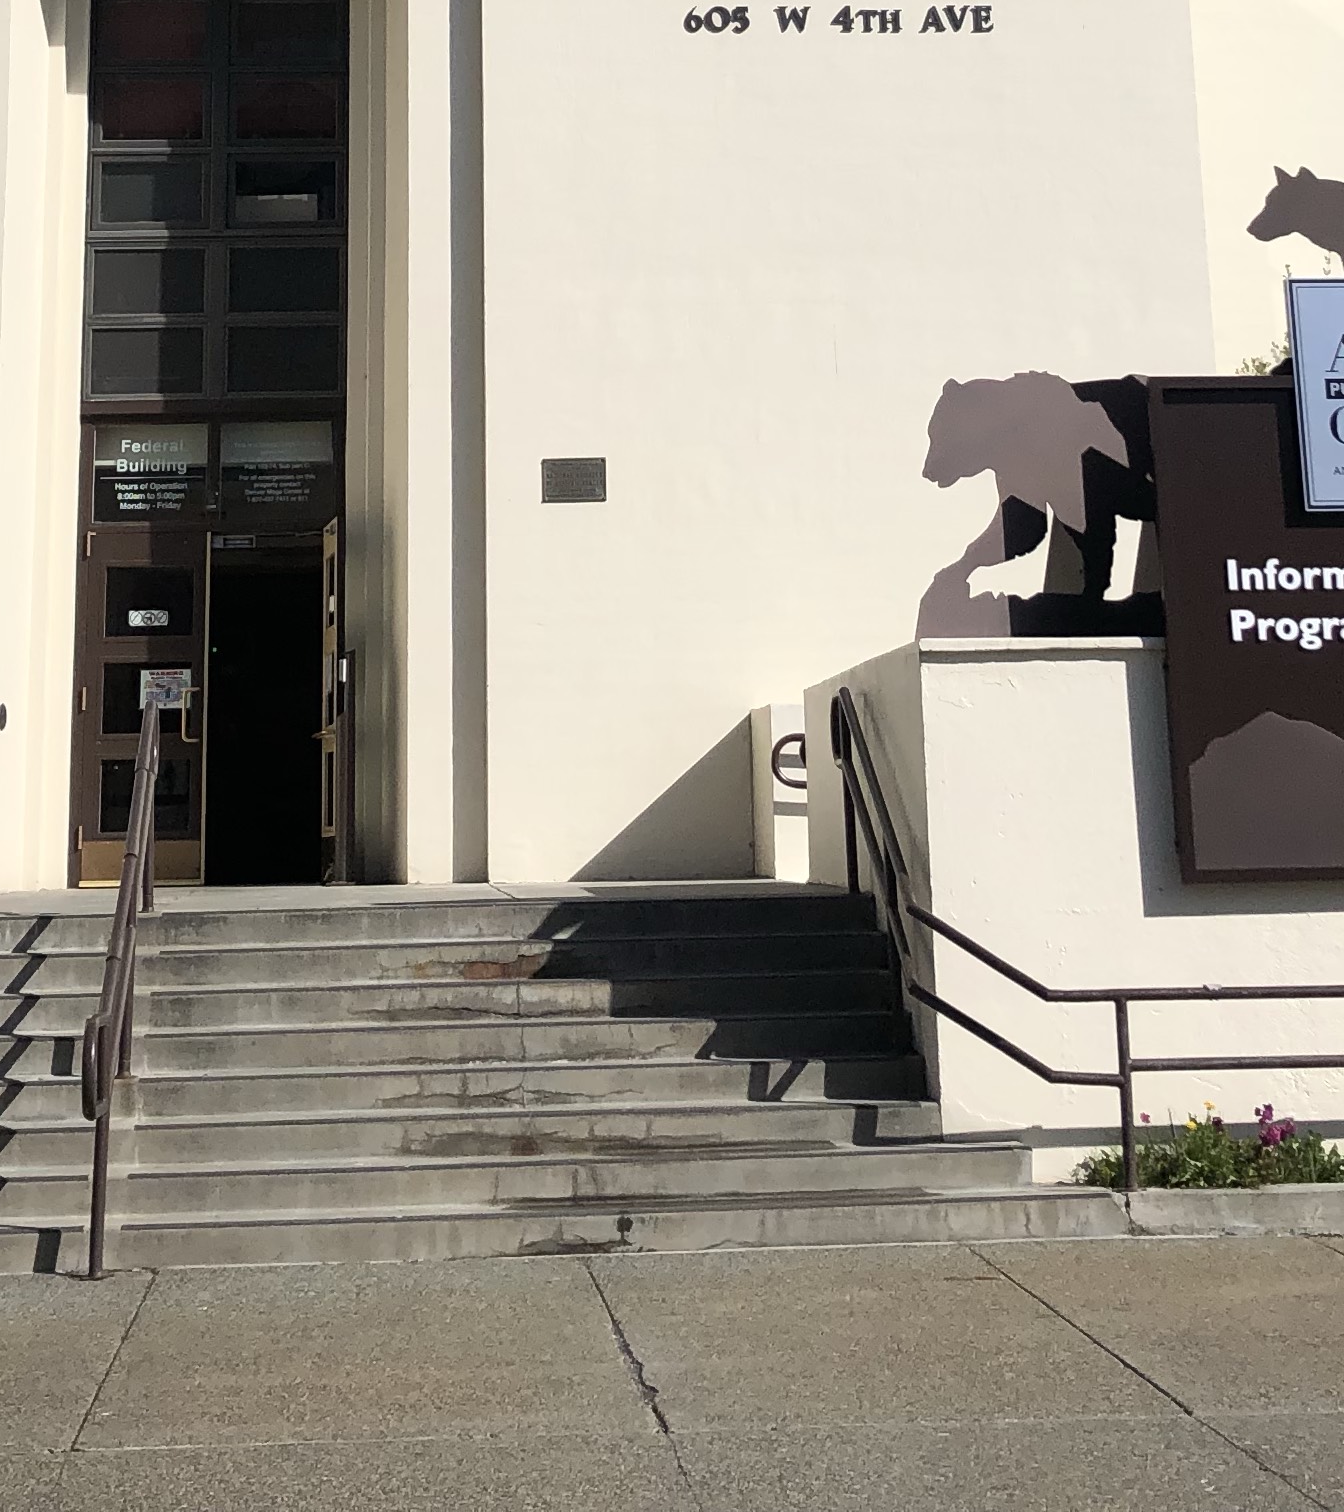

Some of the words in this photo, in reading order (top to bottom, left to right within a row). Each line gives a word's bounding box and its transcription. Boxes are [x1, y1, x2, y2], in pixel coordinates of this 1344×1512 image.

[683, 5, 750, 35] 605
[773, 5, 811, 35] W
[829, 4, 903, 35] 4TH
[918, 4, 995, 35] AVE
[121, 439, 184, 453] Federal
[116, 458, 188, 475] Building
[114, 482, 139, 491] Hours
[139, 482, 149, 490] of
[149, 482, 188, 492] Operation
[116, 492, 146, 500] 8:00am
[146, 492, 155, 500] to
[119, 501, 151, 511] Monday
[156, 501, 182, 511] Friday
